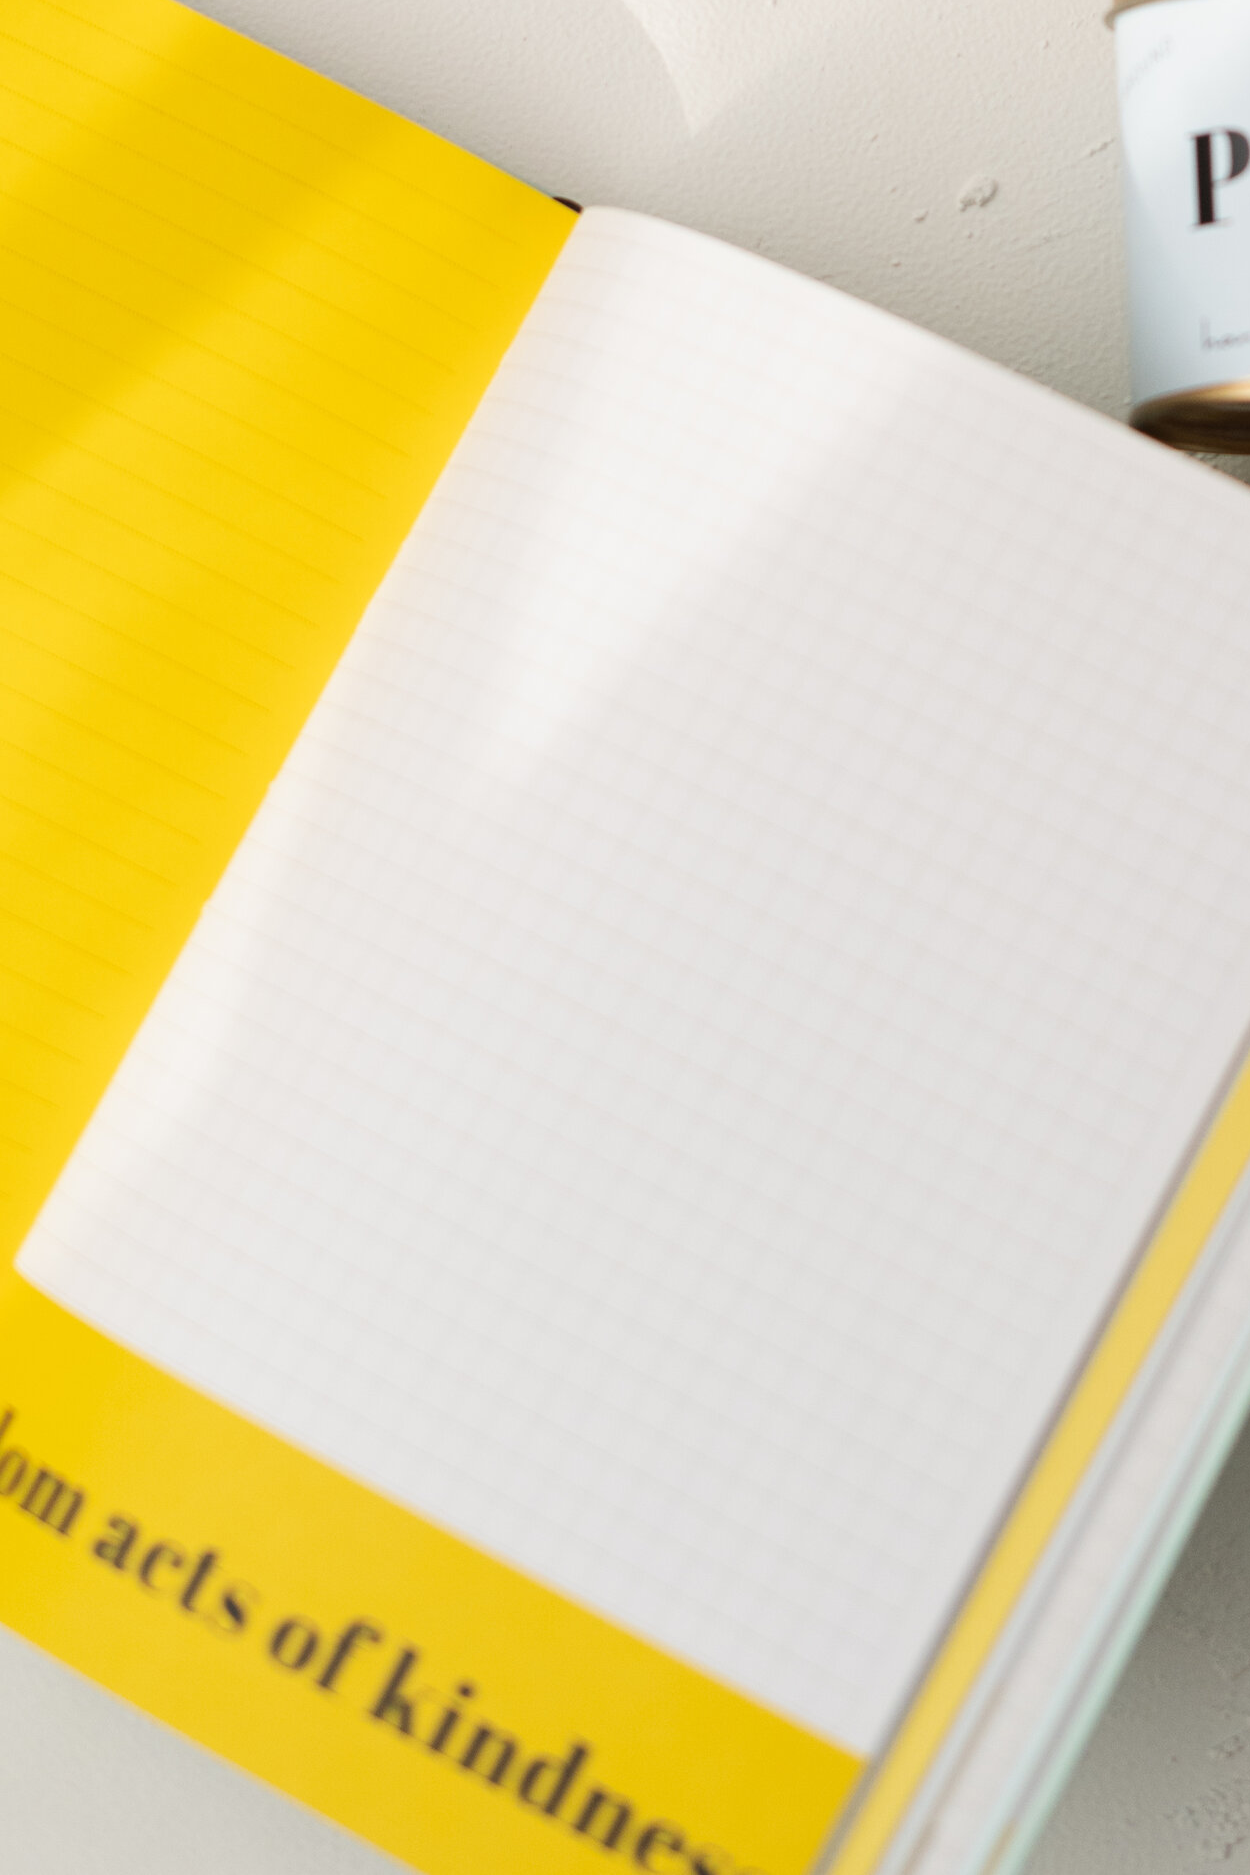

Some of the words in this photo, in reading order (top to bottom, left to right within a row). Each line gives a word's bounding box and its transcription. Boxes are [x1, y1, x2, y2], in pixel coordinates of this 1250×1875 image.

[0, 1406, 86, 1539] om
[92, 1513, 260, 1637] acts
[266, 1617, 384, 1696] of
